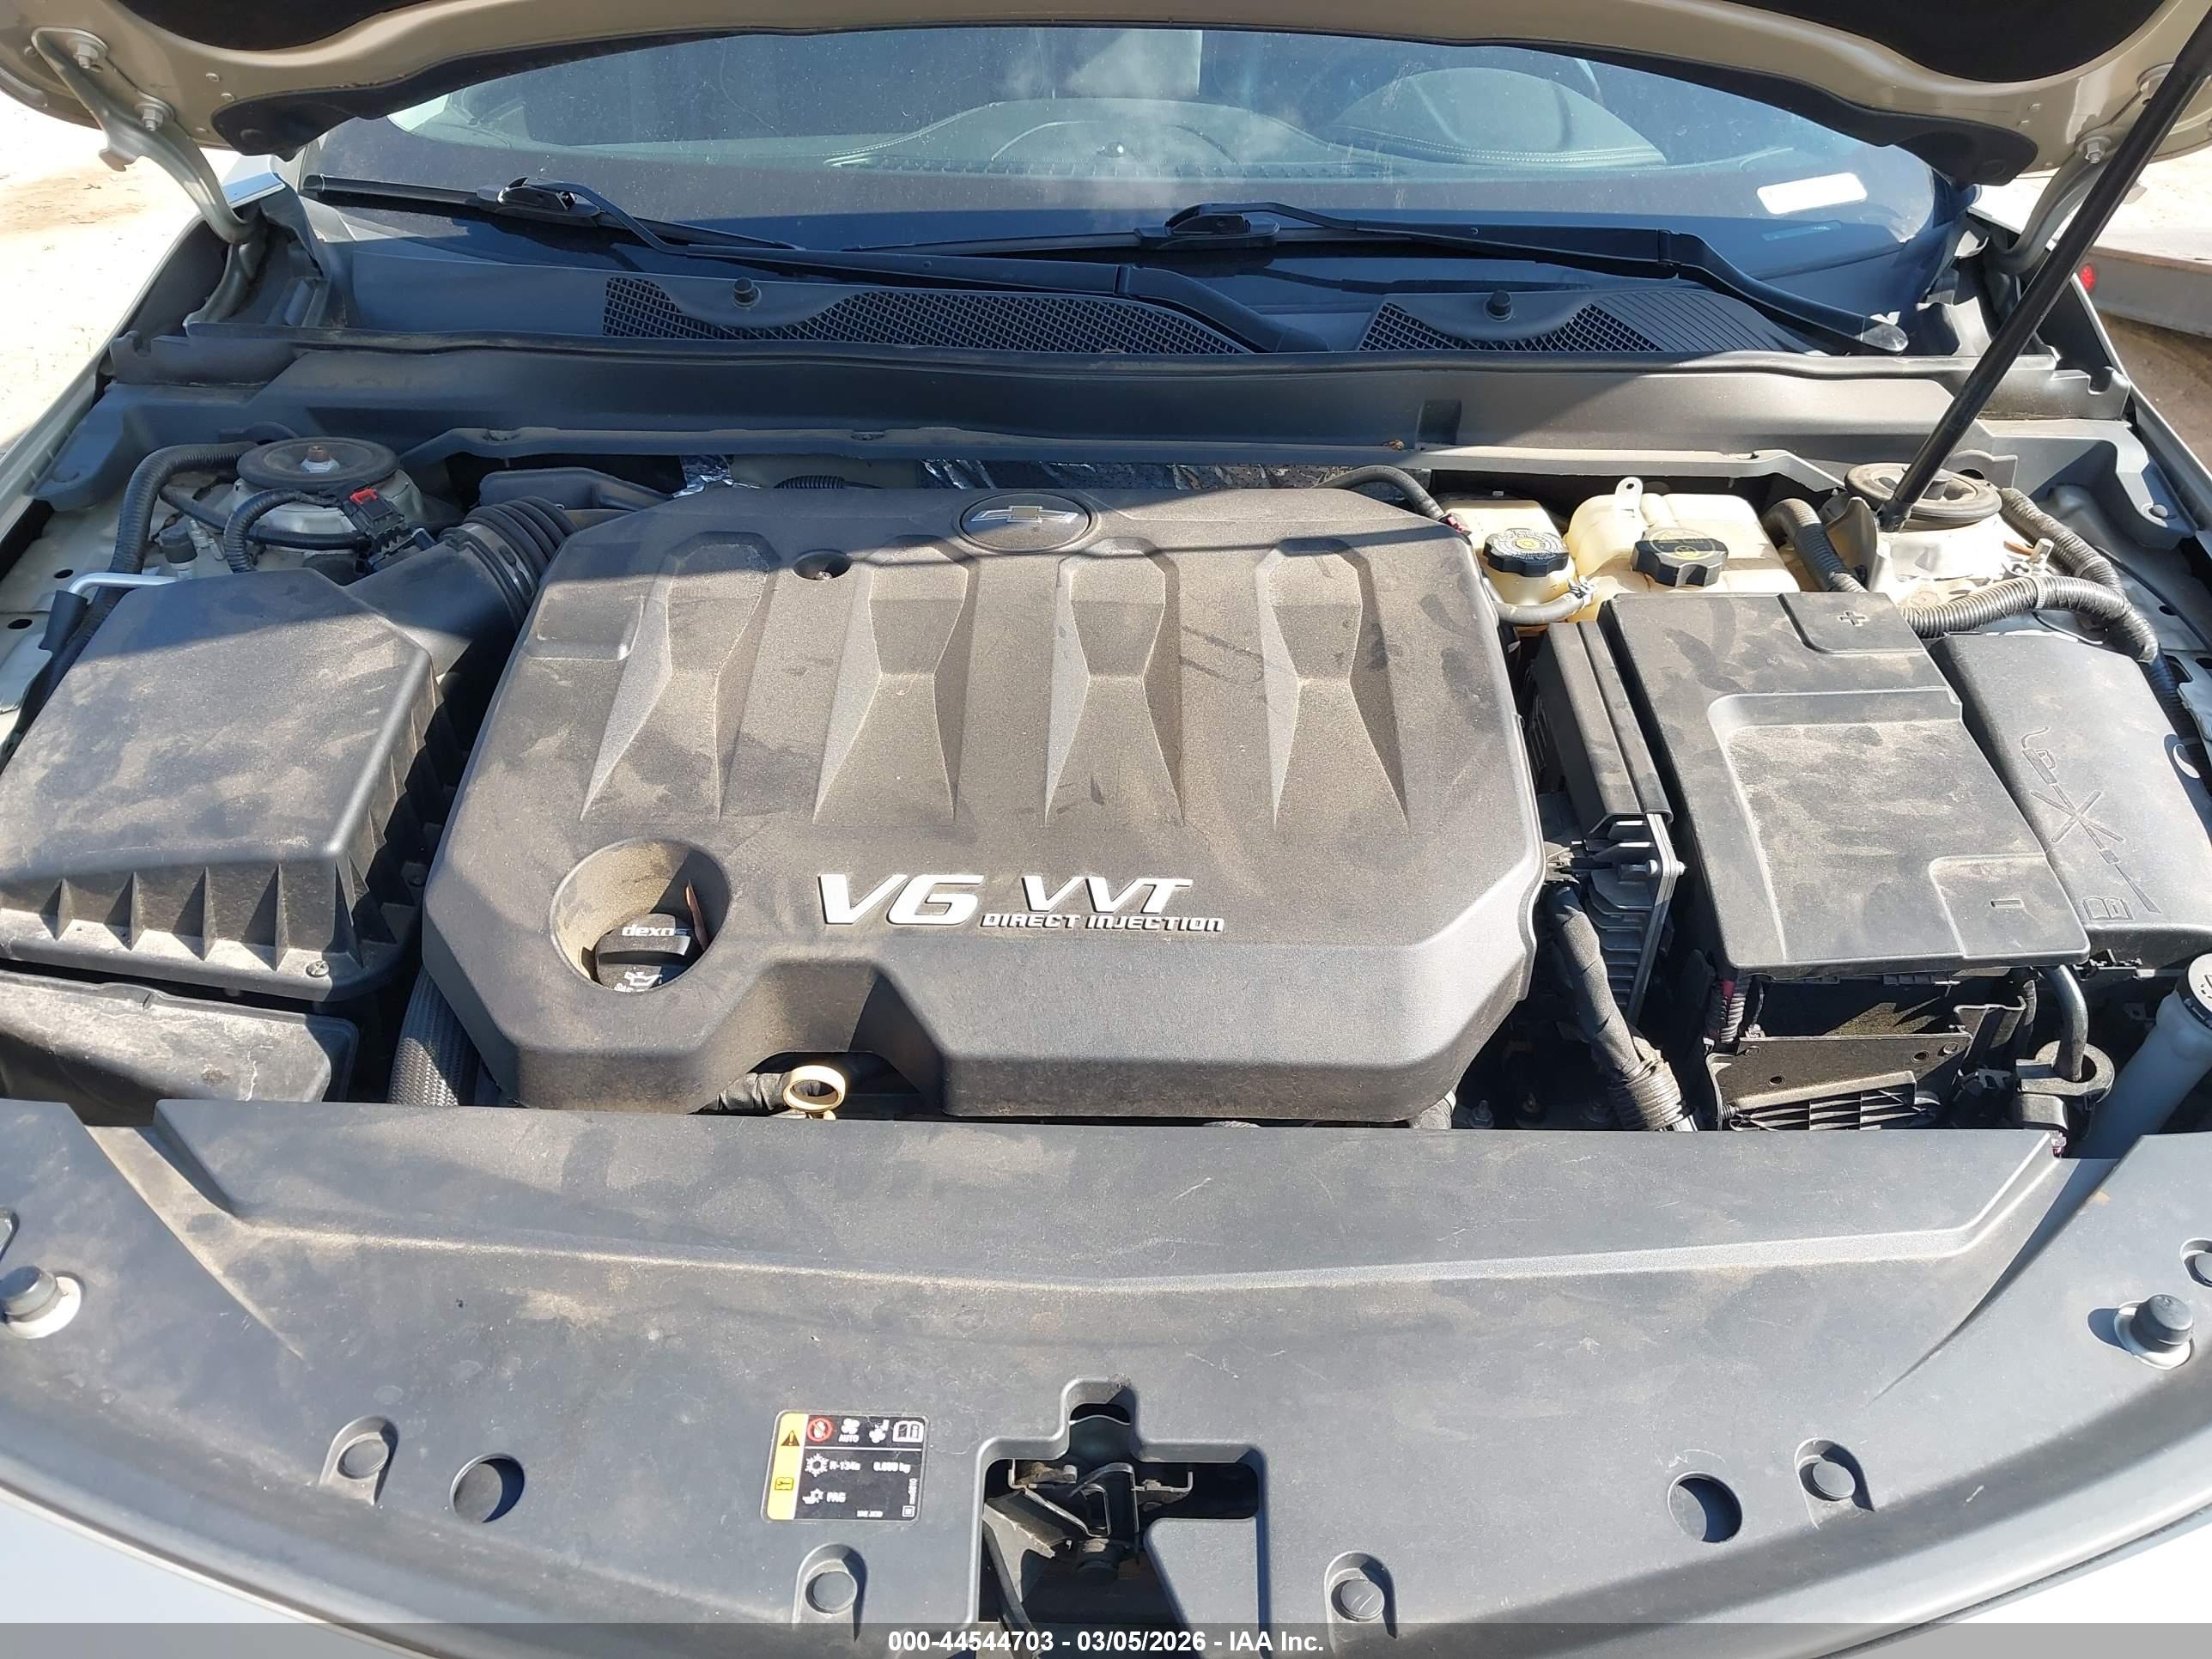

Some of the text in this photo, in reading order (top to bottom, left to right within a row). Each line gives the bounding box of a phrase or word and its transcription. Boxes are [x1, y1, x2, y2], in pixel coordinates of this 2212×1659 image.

[817, 873, 1194, 926] V6 VVT
[981, 914, 1224, 933] DIRECT INJECTION
[838, 1433, 860, 1443] AUTO
